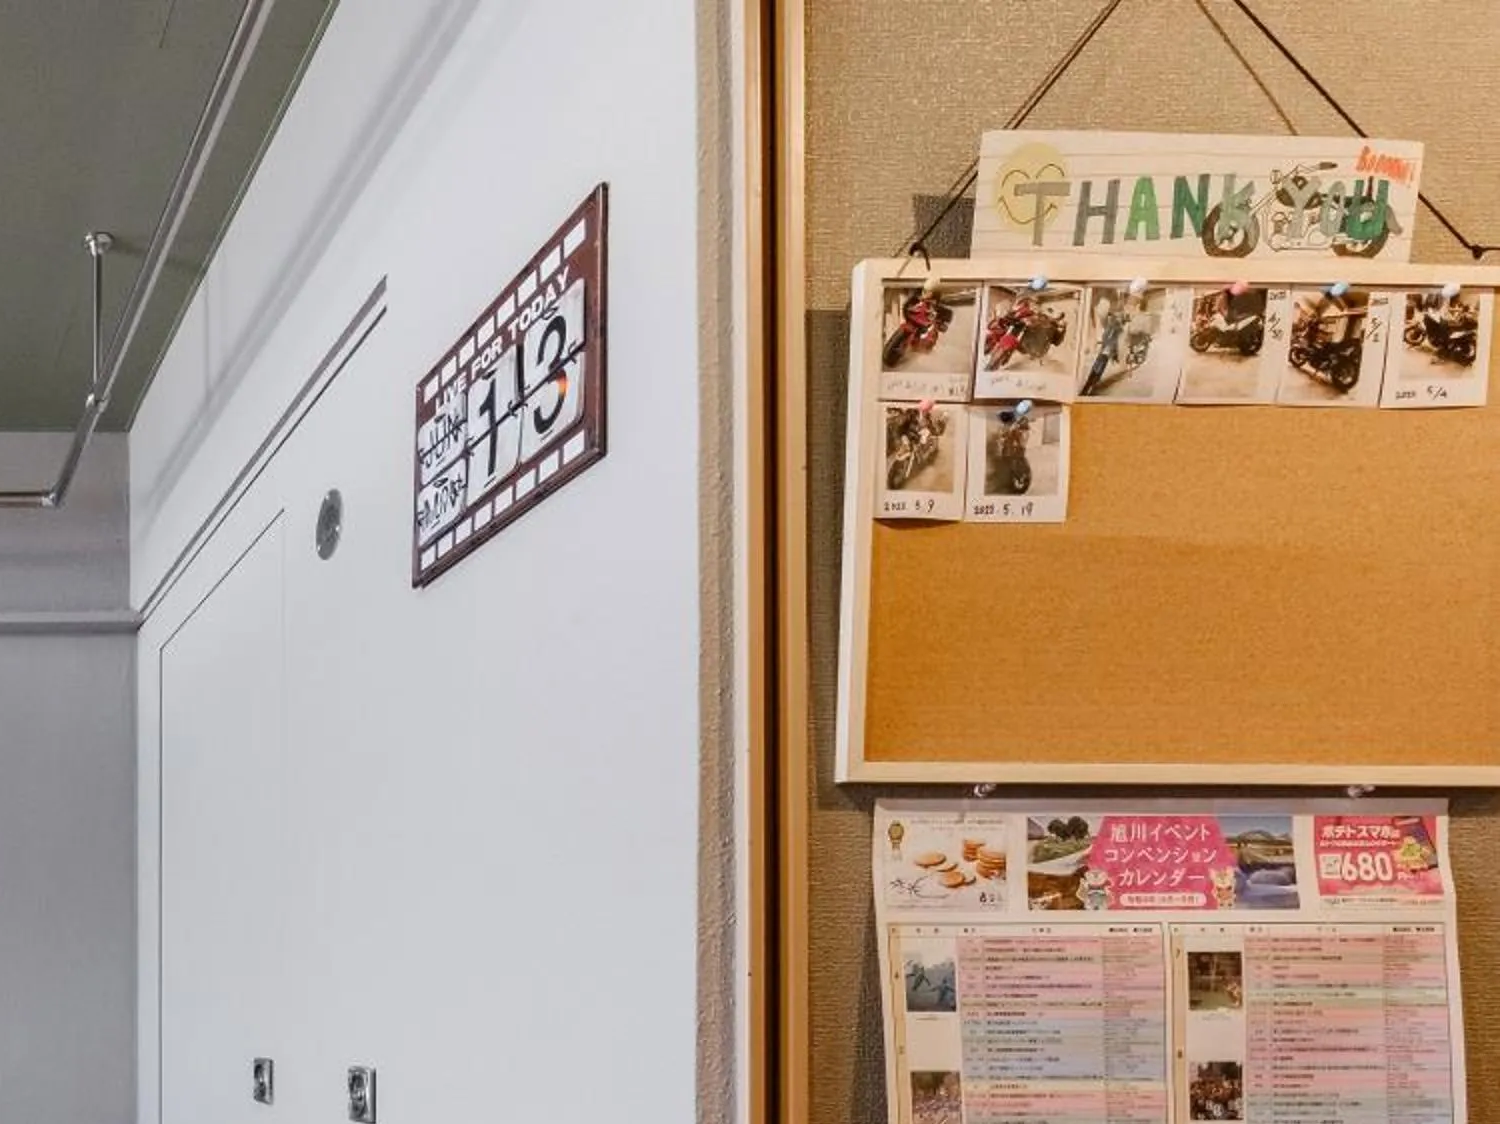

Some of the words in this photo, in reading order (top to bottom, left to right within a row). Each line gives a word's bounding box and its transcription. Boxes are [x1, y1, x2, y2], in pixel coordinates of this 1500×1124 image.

[1013, 172, 1256, 246] THANK
[1279, 173, 1391, 241] YOU
[435, 369, 467, 412] LIVE
[471, 335, 503, 381] FOR
[508, 266, 571, 342] TODAY
[424, 413, 460, 468] JUN
[1110, 822, 1211, 843] 旭川イベント
[1103, 848, 1217, 865] コンベンション
[1342, 851, 1394, 882] 680
[1118, 868, 1205, 888] カレンダー
